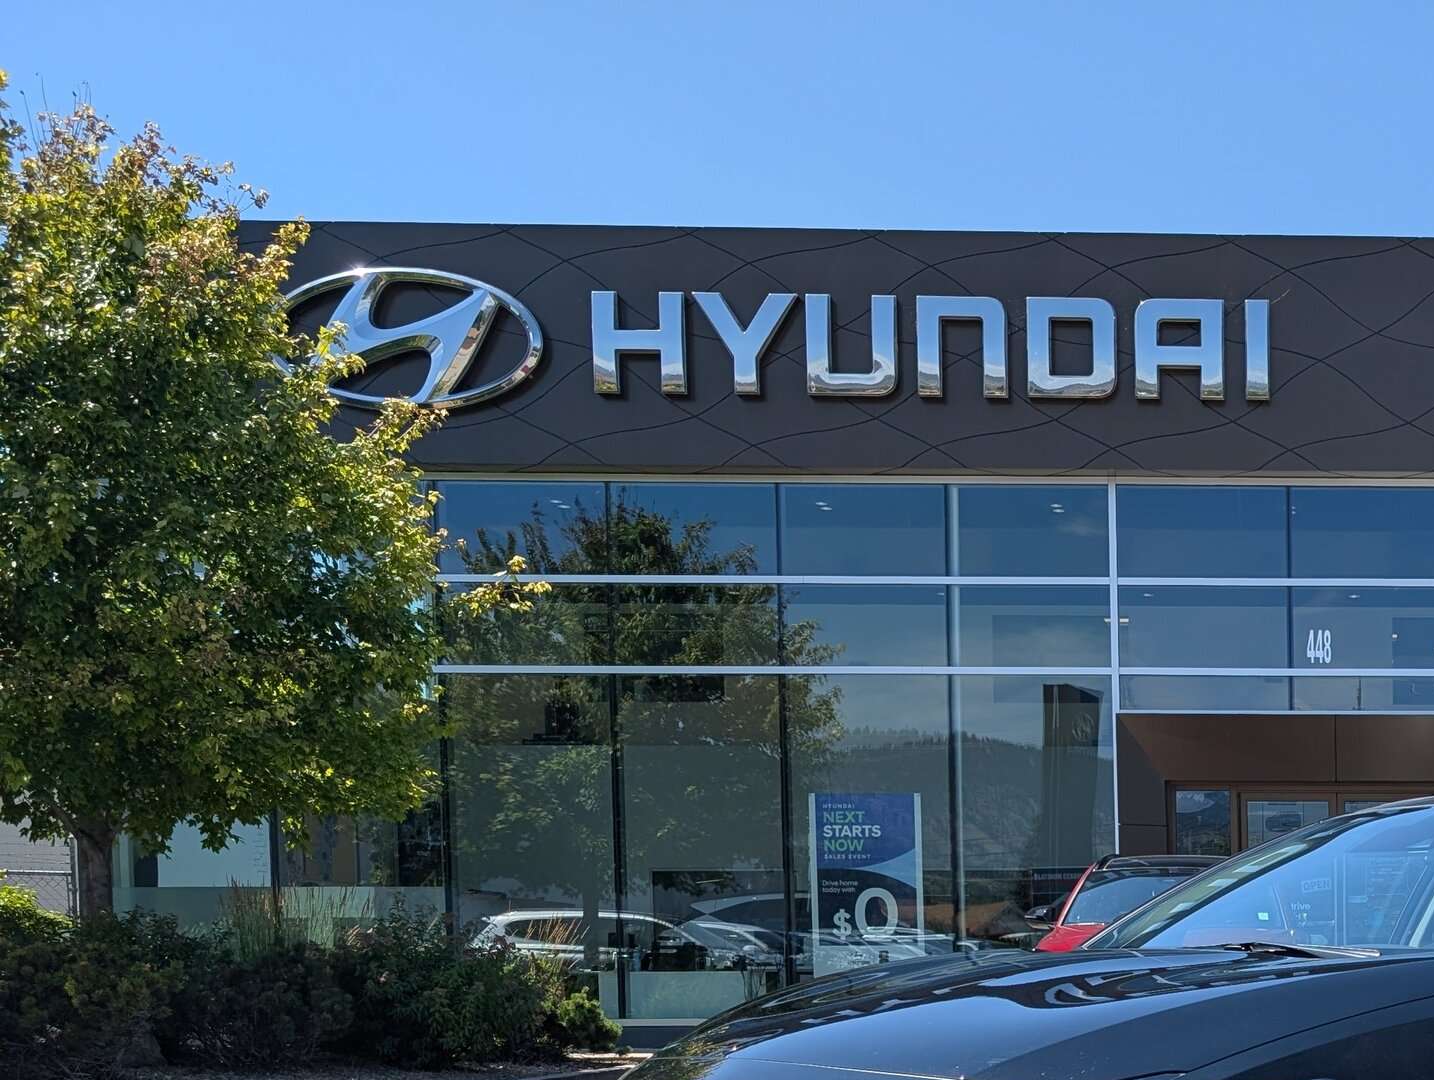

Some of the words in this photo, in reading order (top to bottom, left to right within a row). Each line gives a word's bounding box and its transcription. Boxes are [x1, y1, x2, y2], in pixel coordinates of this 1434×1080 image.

[591, 290, 1271, 401] HYUNDAI
[1306, 628, 1332, 664] 448
[823, 811, 865, 823] NEXT
[823, 825, 882, 837] STARTS
[823, 839, 865, 851] NOW
[1303, 879, 1330, 891] OPEN
